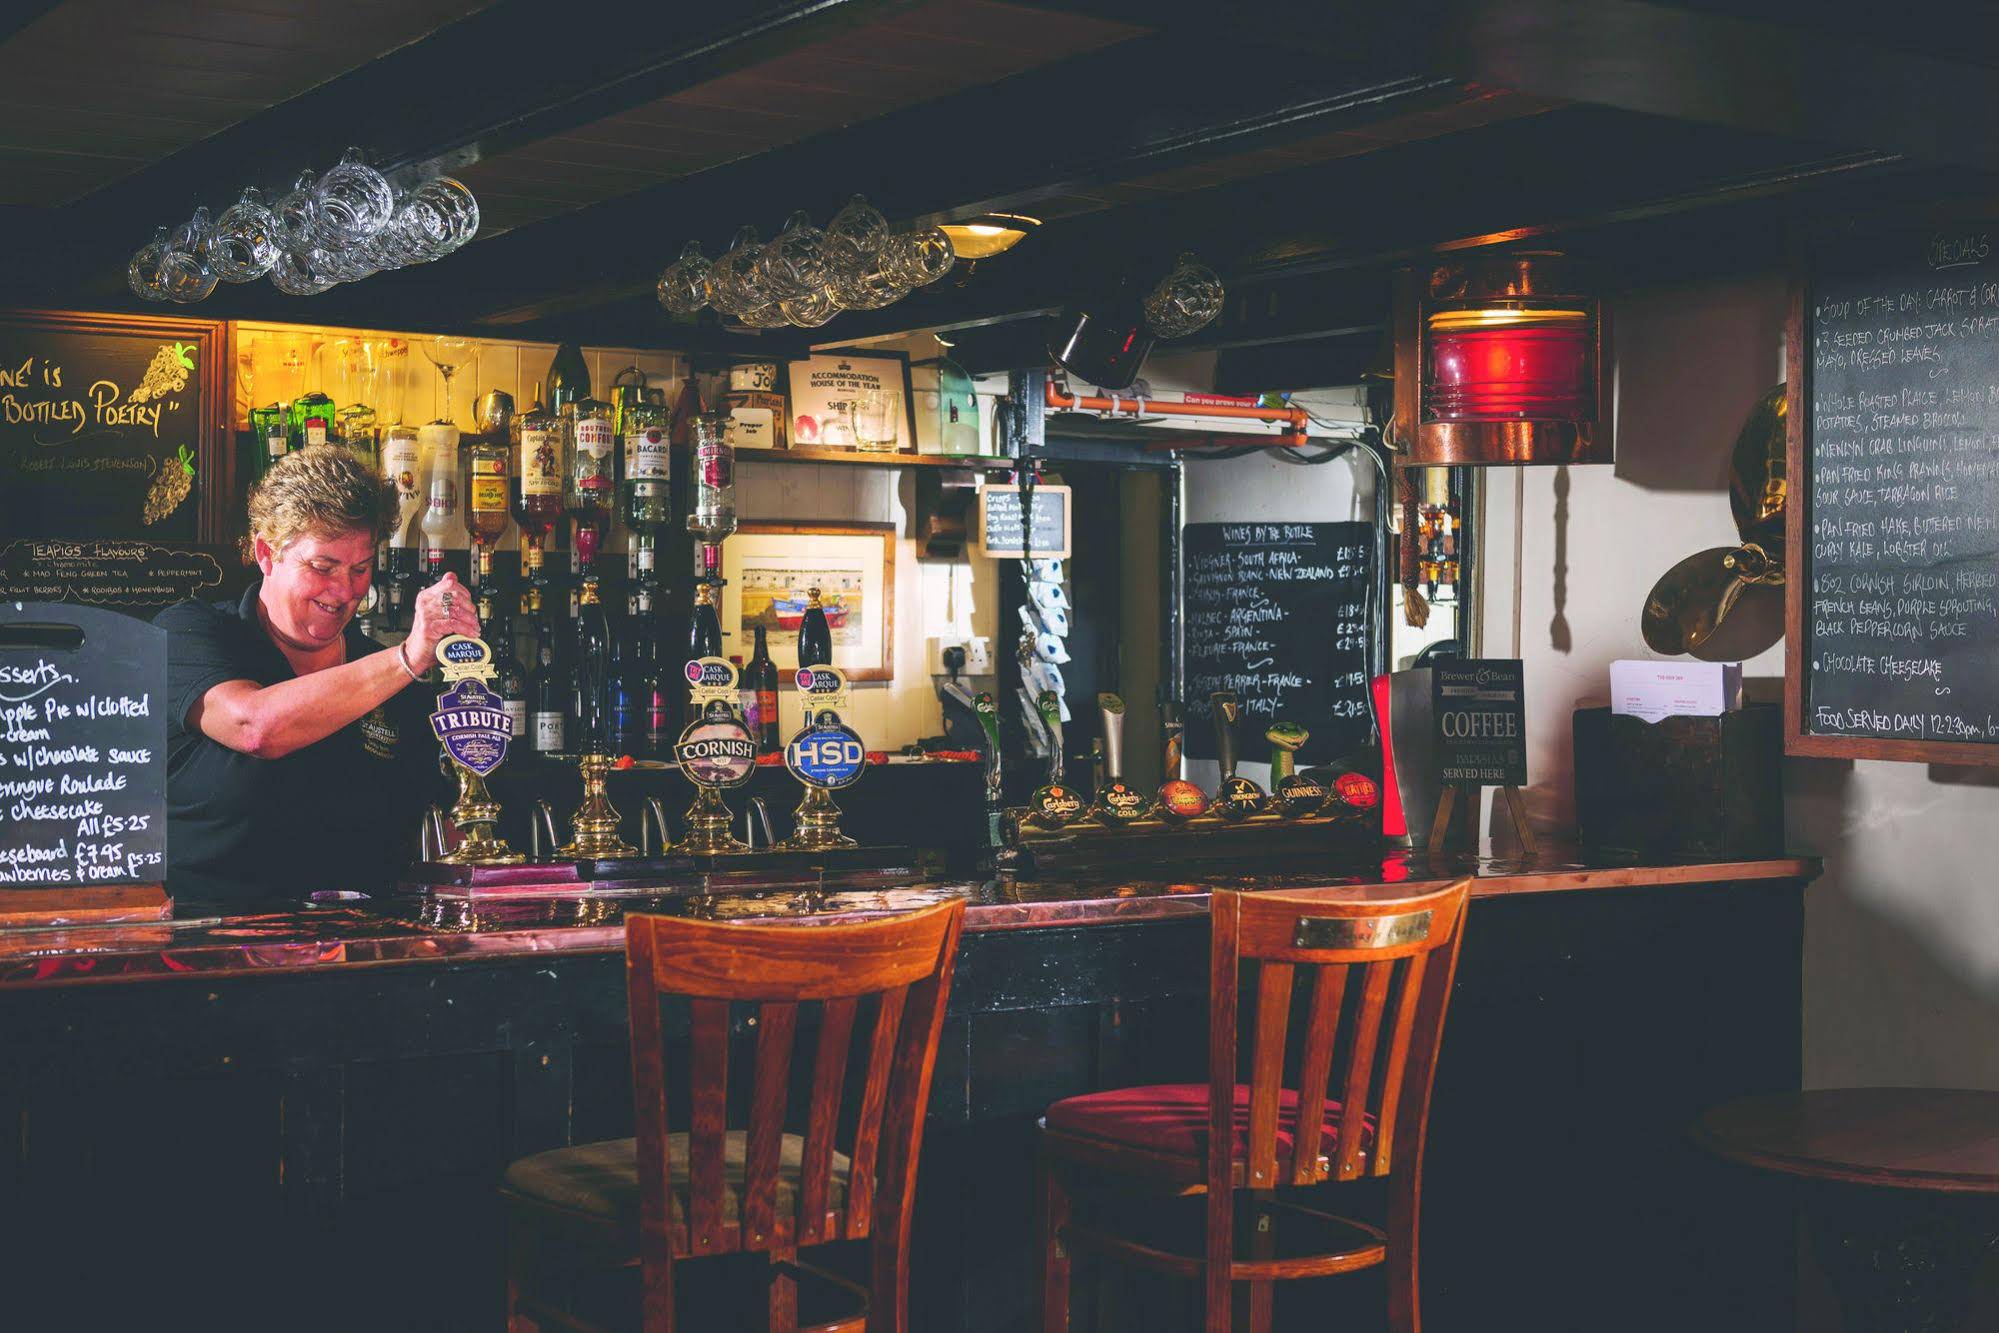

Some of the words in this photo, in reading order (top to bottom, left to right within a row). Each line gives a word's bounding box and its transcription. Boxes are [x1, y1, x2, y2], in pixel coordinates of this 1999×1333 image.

[1858, 297, 1872, 315] OF
[1874, 296, 1894, 320] THE
[1927, 288, 1970, 315] CARROT
[1925, 323, 1955, 339] JACK
[1851, 348, 1896, 372] DRESSED
[1901, 345, 1941, 363] LEAVES
[811, 372, 880, 382] ACCOMMODATION
[827, 401, 848, 410] SHIP
[1859, 391, 1898, 413] ROASTED
[1871, 412, 1919, 431] STEAMED
[1868, 437, 1893, 457] CRAB
[1821, 466, 1839, 484] PAN
[1842, 466, 1871, 484] FRIED
[1816, 489, 1843, 509] SOUR
[1877, 484, 1930, 509] TARRAGON
[1934, 485, 1959, 500] RICE
[1222, 525, 1251, 544] WINES
[1255, 526, 1267, 542] BY
[1284, 525, 1315, 542] BOTTLE
[1821, 517, 1842, 540] PAN
[1844, 521, 1876, 542] FRIED
[1238, 551, 1265, 567] SOUTH
[1883, 540, 1929, 562] LOBSTER
[1269, 567, 1294, 581] NEW
[1294, 567, 1334, 581] ZEALAND
[1850, 572, 1895, 596] CORNISH
[1230, 604, 1283, 627] ARGENTINA
[1814, 598, 1854, 619] FRENCH
[1224, 626, 1253, 641] SPAIN
[1815, 618, 1845, 637] BLACK
[1850, 617, 1923, 642] PEPPERCORN
[1930, 620, 1968, 639] SAUCE
[447, 650, 483, 659] MARQUE
[1823, 651, 1876, 675] CHOCOLATE
[1879, 654, 1942, 681] CHEESECAKE
[1440, 671, 1475, 682] Brewer
[1476, 668, 1490, 684] &
[1246, 699, 1277, 718] ITALY
[435, 711, 511, 732] TRIBUTE
[1442, 711, 1517, 737] COFFEE
[1816, 706, 1845, 730] FOOD
[1846, 708, 1891, 731] SERVED
[1894, 713, 1924, 739] DAILY
[451, 733, 477, 741] CORNISH
[108, 748, 151, 764] sauce
[683, 741, 753, 759] CORNISH
[791, 741, 863, 767] HSD
[60, 772, 127, 794] Roulade
[1443, 768, 1478, 779] SERVED
[1480, 769, 1505, 779] HERE
[1107, 791, 1142, 806] Carlsberg
[1282, 785, 1322, 798] GUINNESS
[1043, 796, 1079, 813] Carlsberg
[77, 817, 99, 837] All
